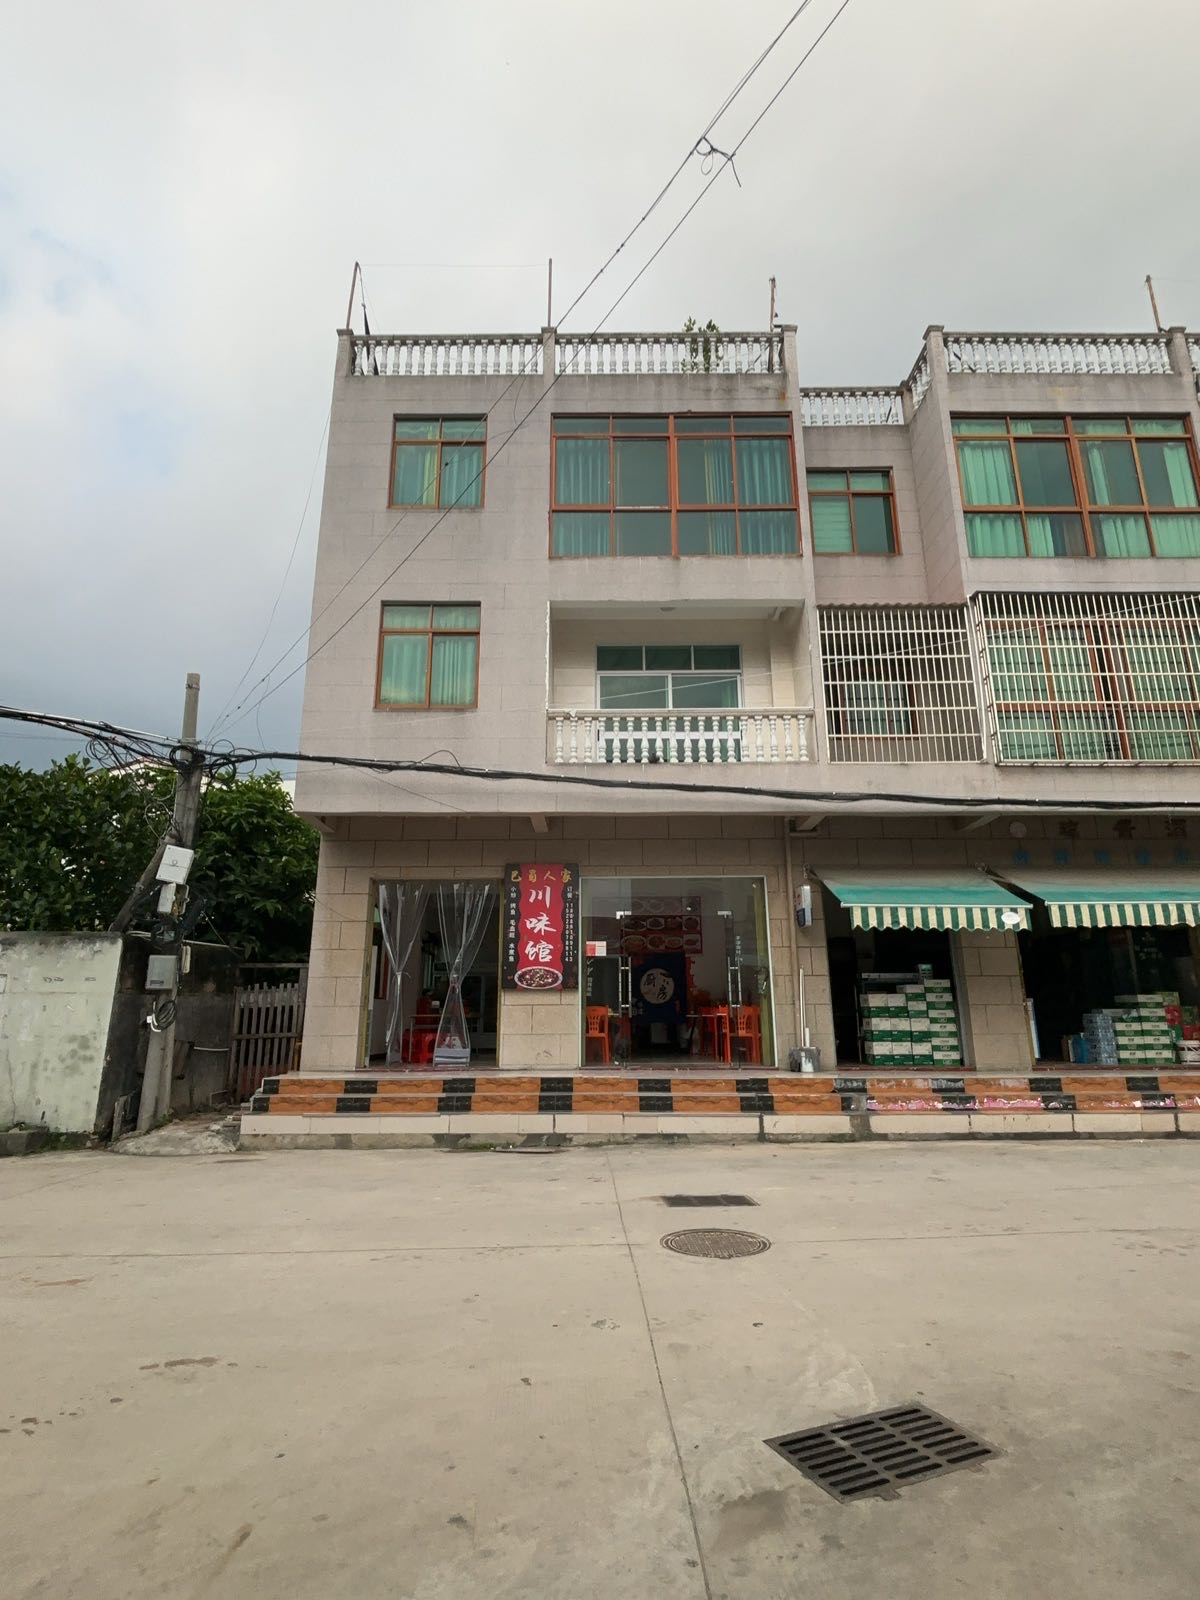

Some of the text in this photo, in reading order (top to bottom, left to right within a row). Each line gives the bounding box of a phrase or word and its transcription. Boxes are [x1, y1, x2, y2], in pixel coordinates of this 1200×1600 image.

[511, 868, 572, 883] 巴蜀人家
[524, 885, 557, 962] 川味馆
